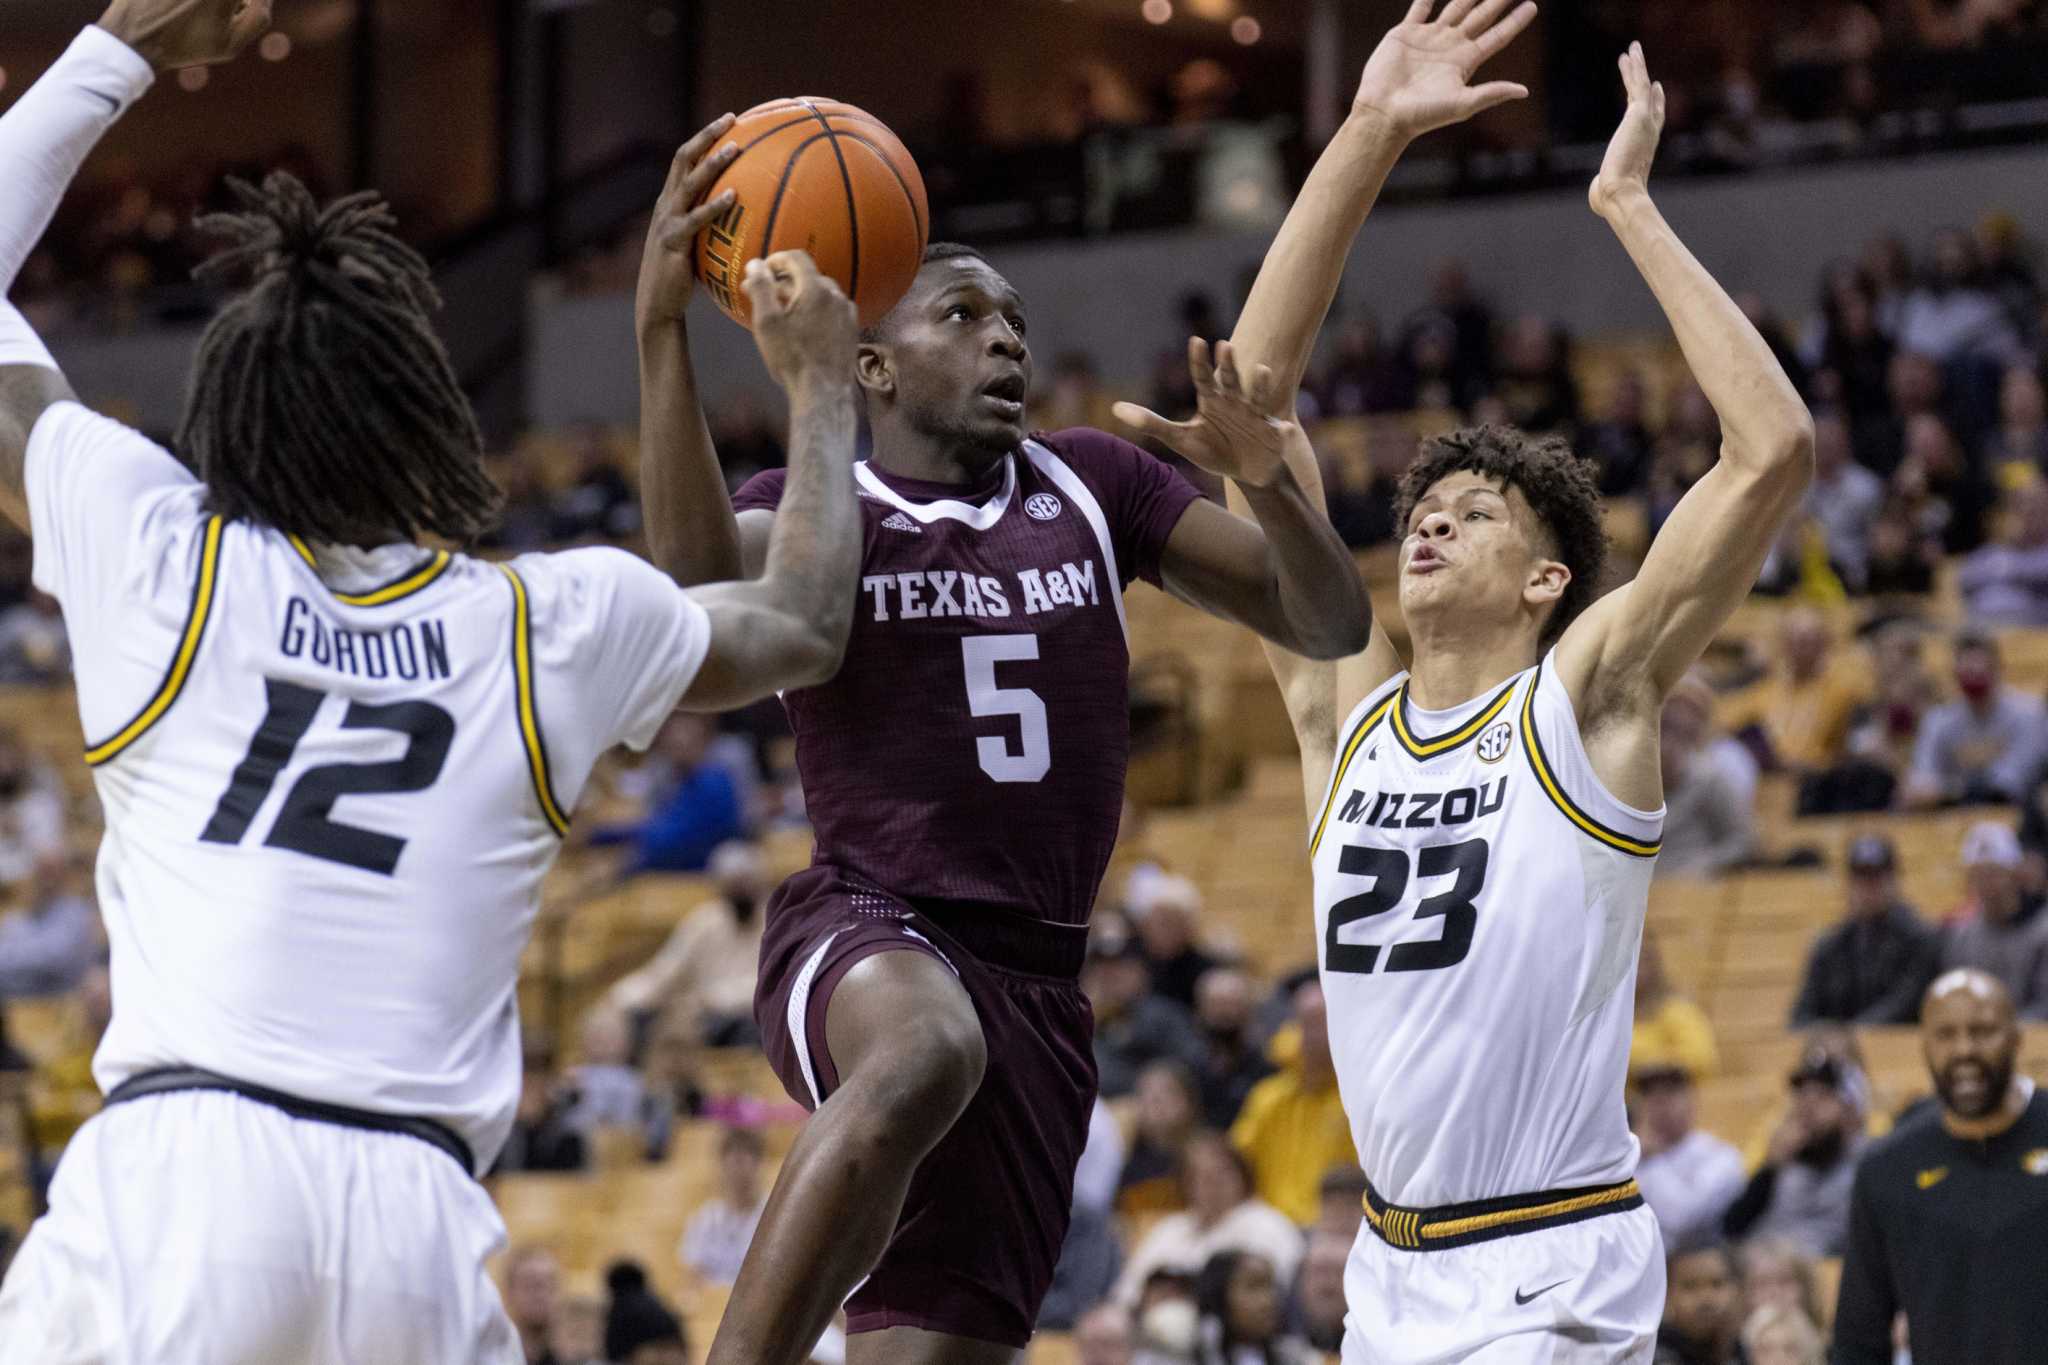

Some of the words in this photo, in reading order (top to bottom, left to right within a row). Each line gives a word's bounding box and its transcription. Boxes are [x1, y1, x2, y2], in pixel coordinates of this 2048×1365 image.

[704, 202, 744, 309] ELITE
[881, 520, 922, 534] adidas
[1026, 494, 1060, 519] SEC
[862, 570, 1010, 622] TEXAS
[1017, 560, 1099, 615] A&M
[280, 596, 451, 681] GORDON
[961, 633, 1050, 783] 5
[1478, 722, 1512, 763] SEC
[198, 676, 456, 877] 12
[1337, 775, 1508, 828] MIZZOU
[1325, 838, 1489, 974] 23
